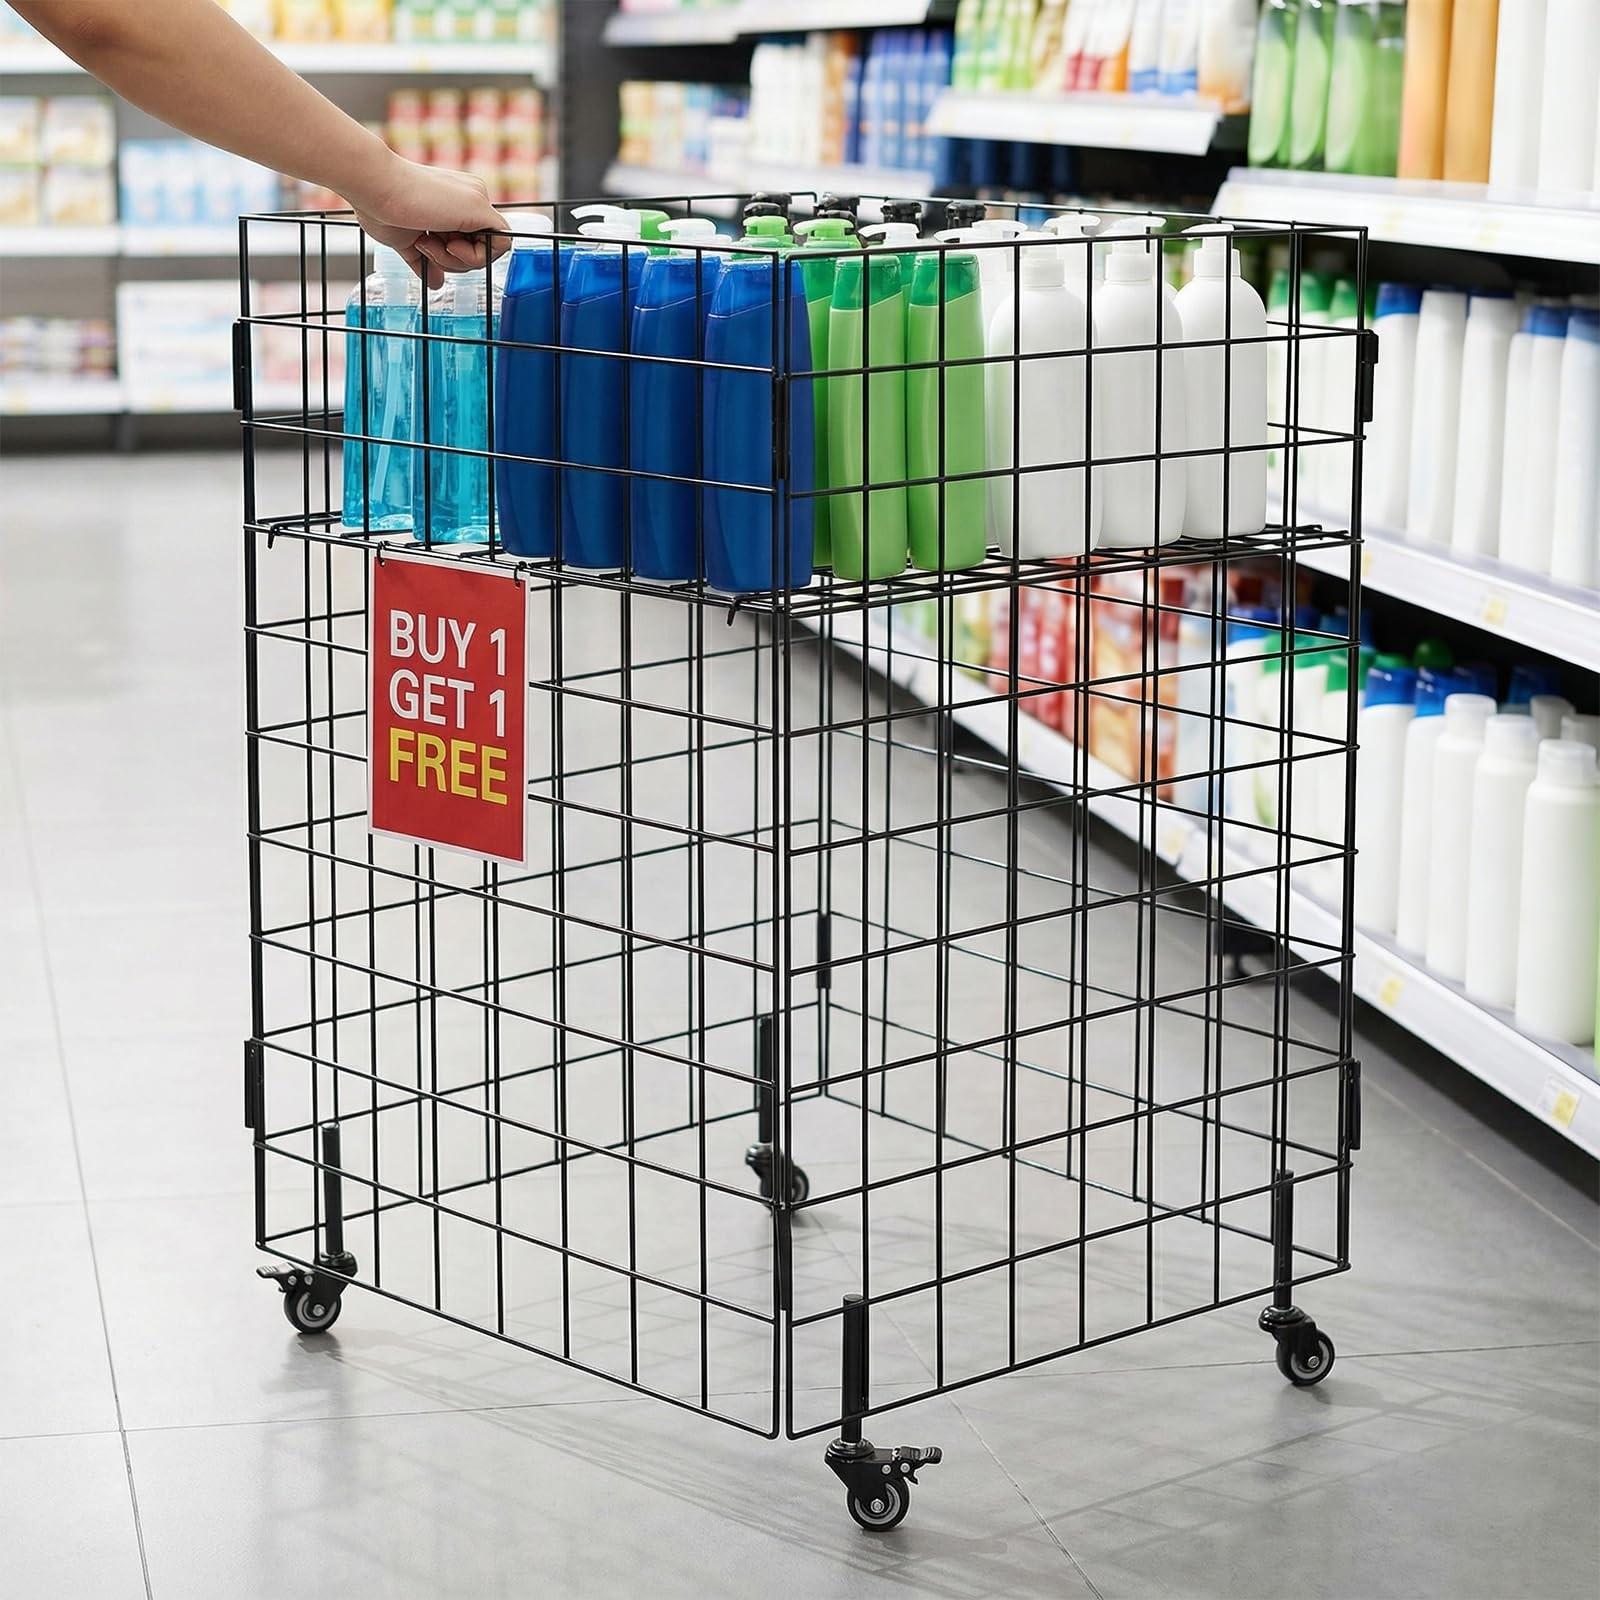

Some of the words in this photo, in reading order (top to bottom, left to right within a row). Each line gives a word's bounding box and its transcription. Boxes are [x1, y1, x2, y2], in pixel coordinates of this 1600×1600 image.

[390, 609, 476, 669] BUY
[490, 628, 506, 676] 1
[389, 669, 475, 729] GET
[489, 689, 505, 737] 1
[390, 727, 508, 806] FREE
